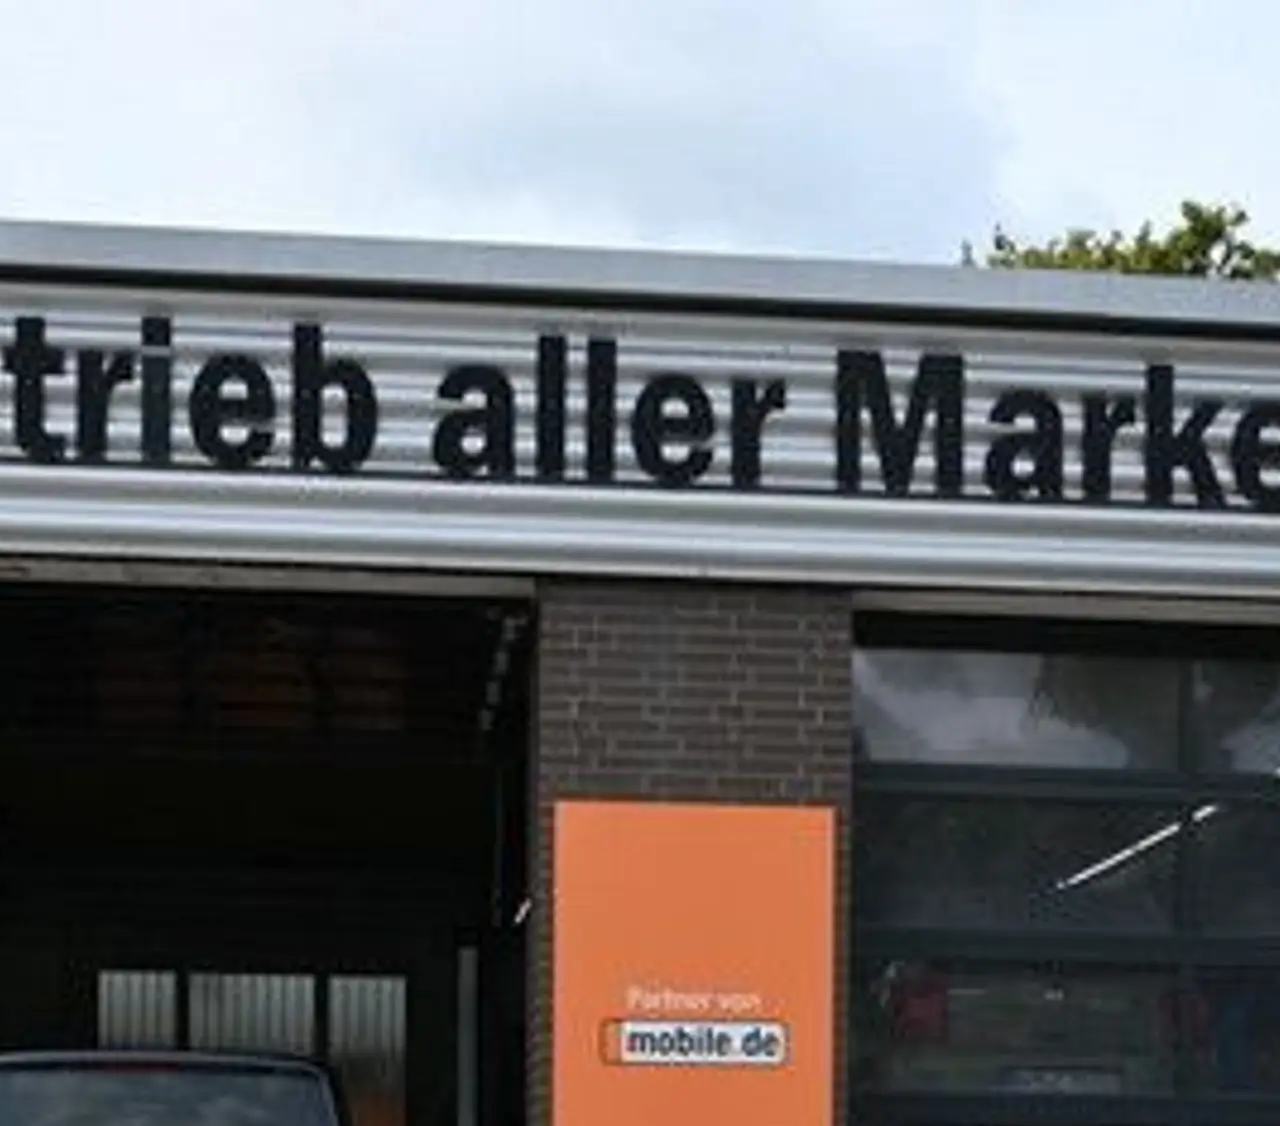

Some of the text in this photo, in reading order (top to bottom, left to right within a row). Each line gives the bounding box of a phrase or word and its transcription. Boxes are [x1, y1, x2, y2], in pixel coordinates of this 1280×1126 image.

[431, 333, 786, 488] aller
[626, 985, 762, 1012] Partner von
[627, 1026, 782, 1058] mobile.de
